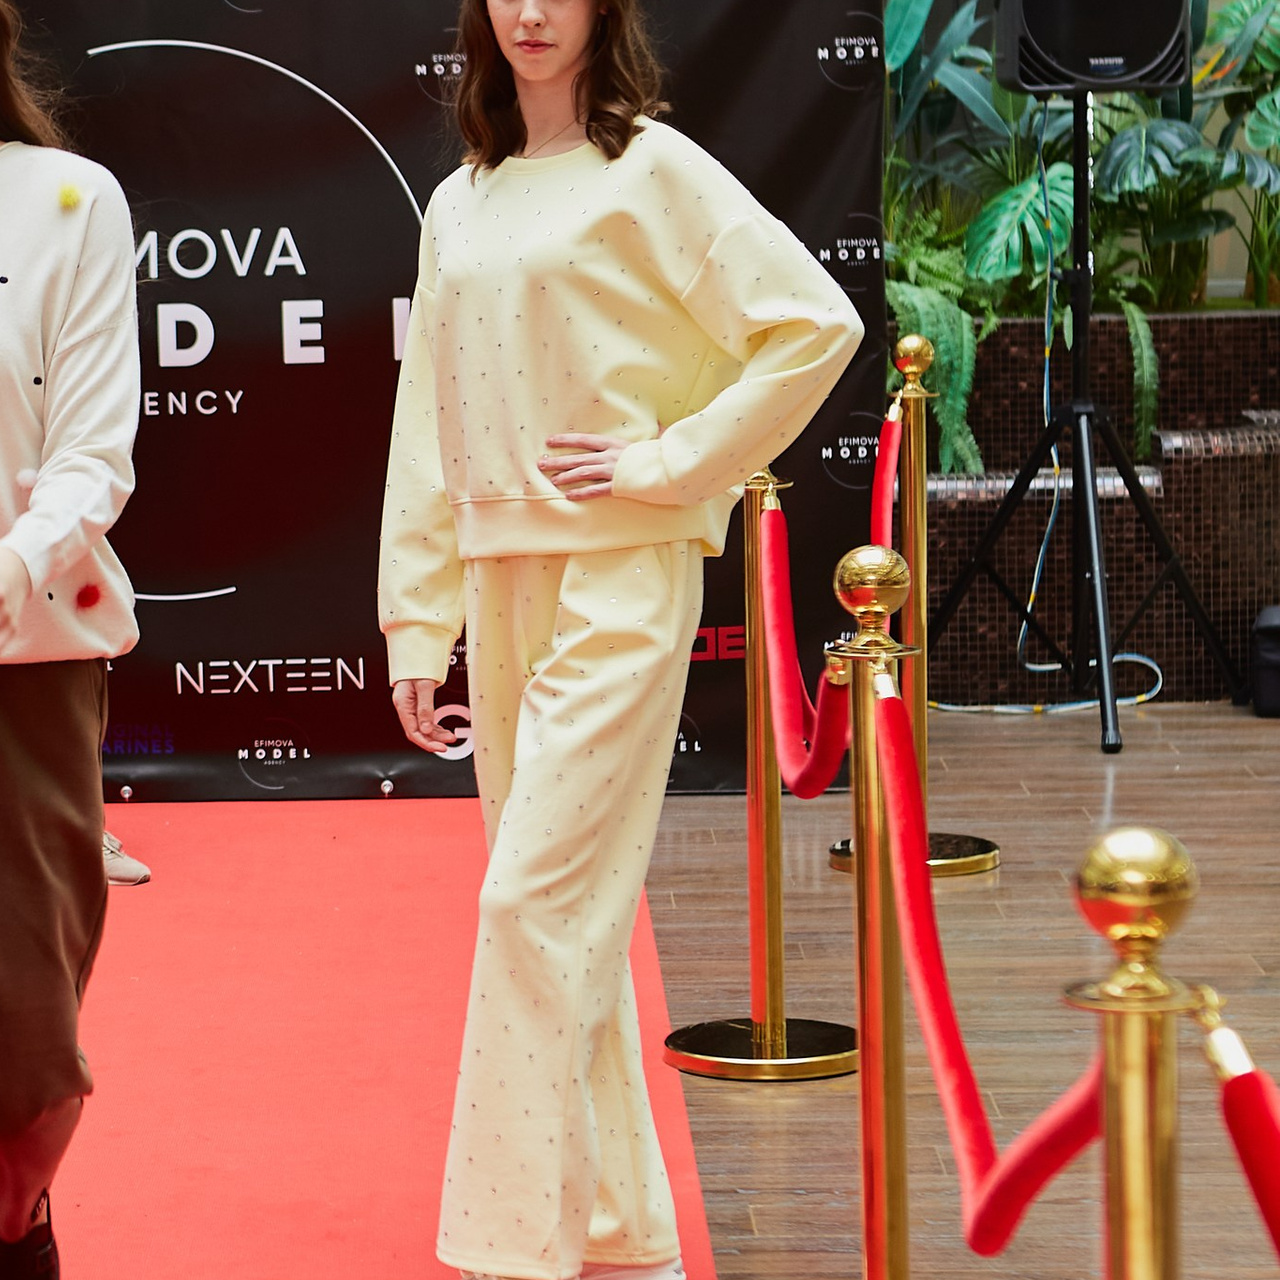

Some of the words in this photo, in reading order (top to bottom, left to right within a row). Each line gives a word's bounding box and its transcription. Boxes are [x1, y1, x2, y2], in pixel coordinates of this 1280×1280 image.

[836, 237, 879, 248] EFIMOVA
[838, 436, 880, 447] EFIMOVA
[175, 656, 365, 695] NEXTEEN
[254, 739, 294, 748] EFIMOVA
[238, 748, 311, 760] MODEL
